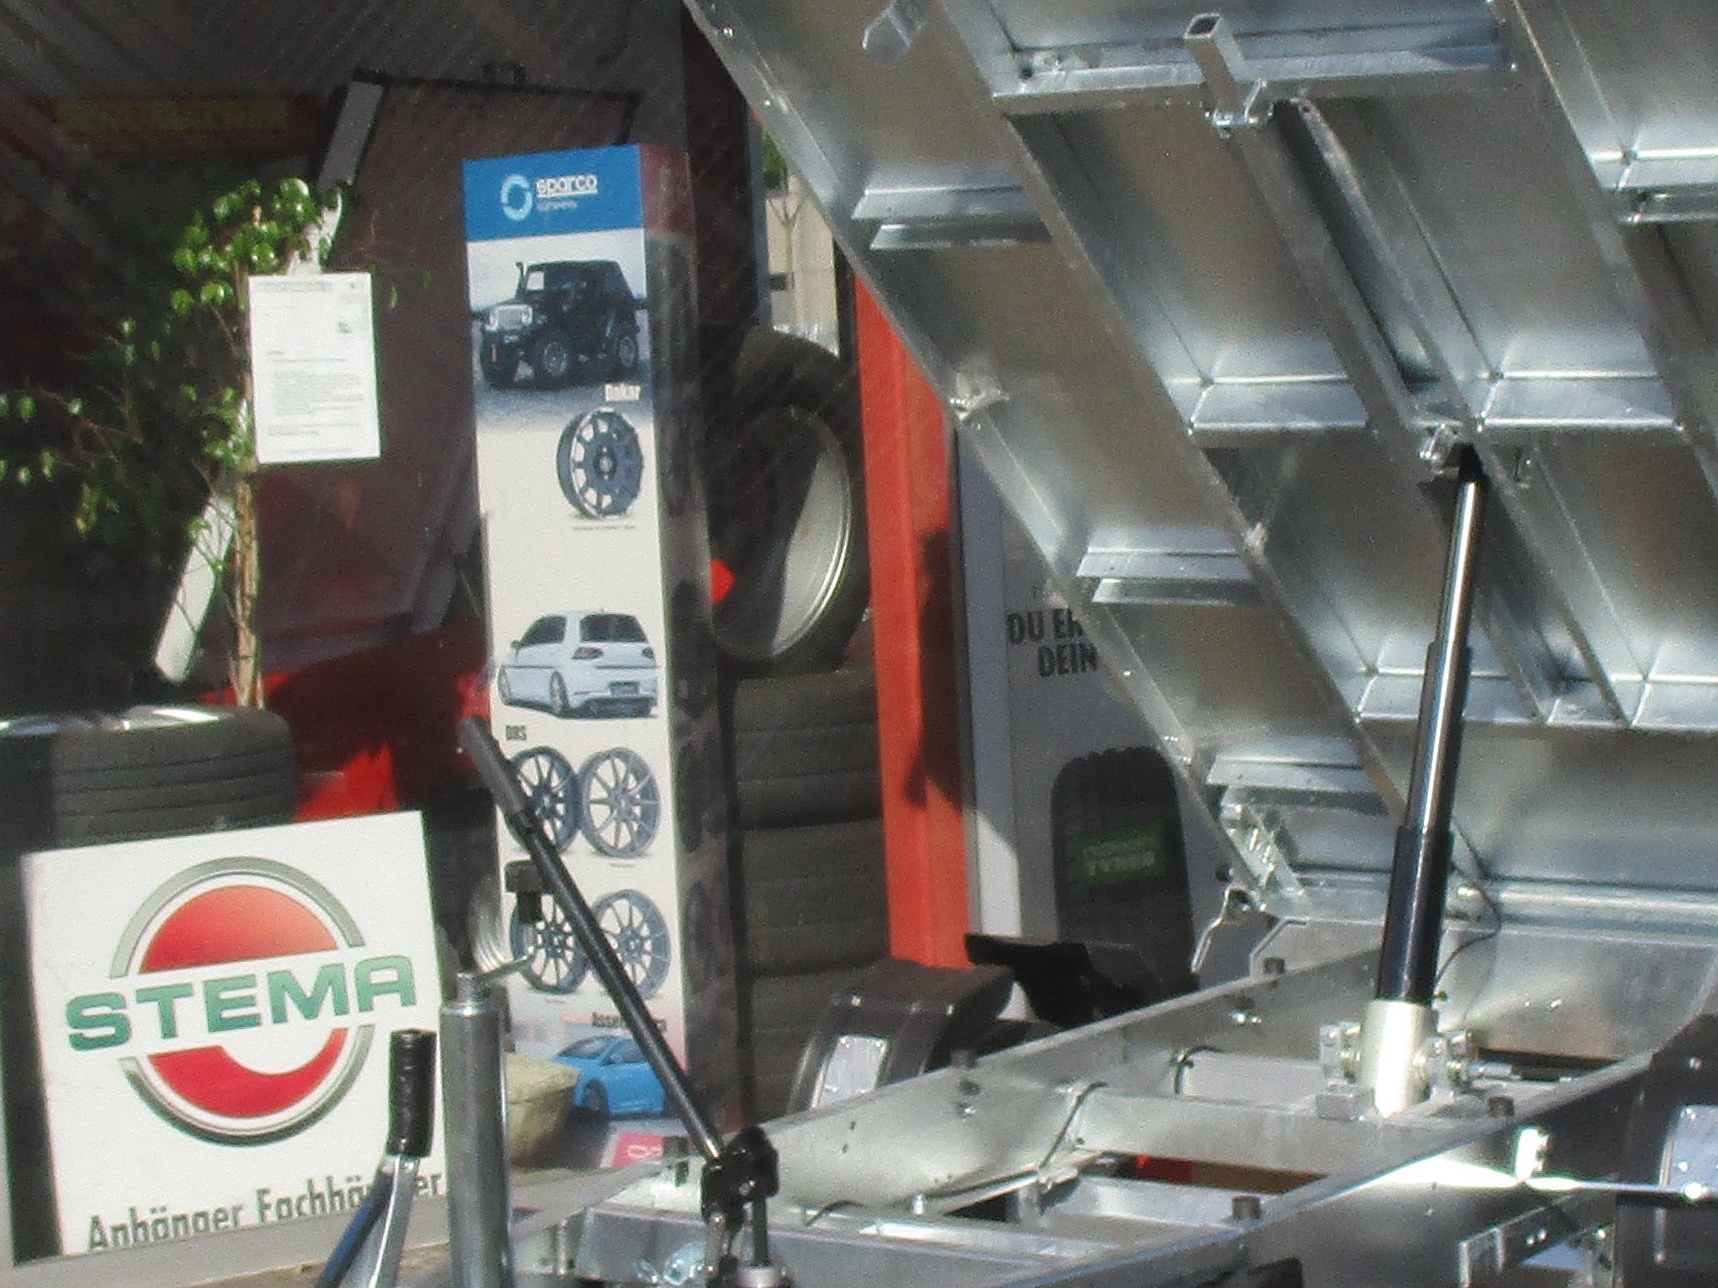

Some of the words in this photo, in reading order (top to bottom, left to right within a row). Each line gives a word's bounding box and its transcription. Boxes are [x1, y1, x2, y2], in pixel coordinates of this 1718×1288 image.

[536, 174, 598, 198] sparco
[1007, 611, 1044, 644] DU
[65, 954, 417, 1052] STEMA
[87, 1204, 245, 1252] Anhänger
[255, 1169, 444, 1226] Fachhäer
